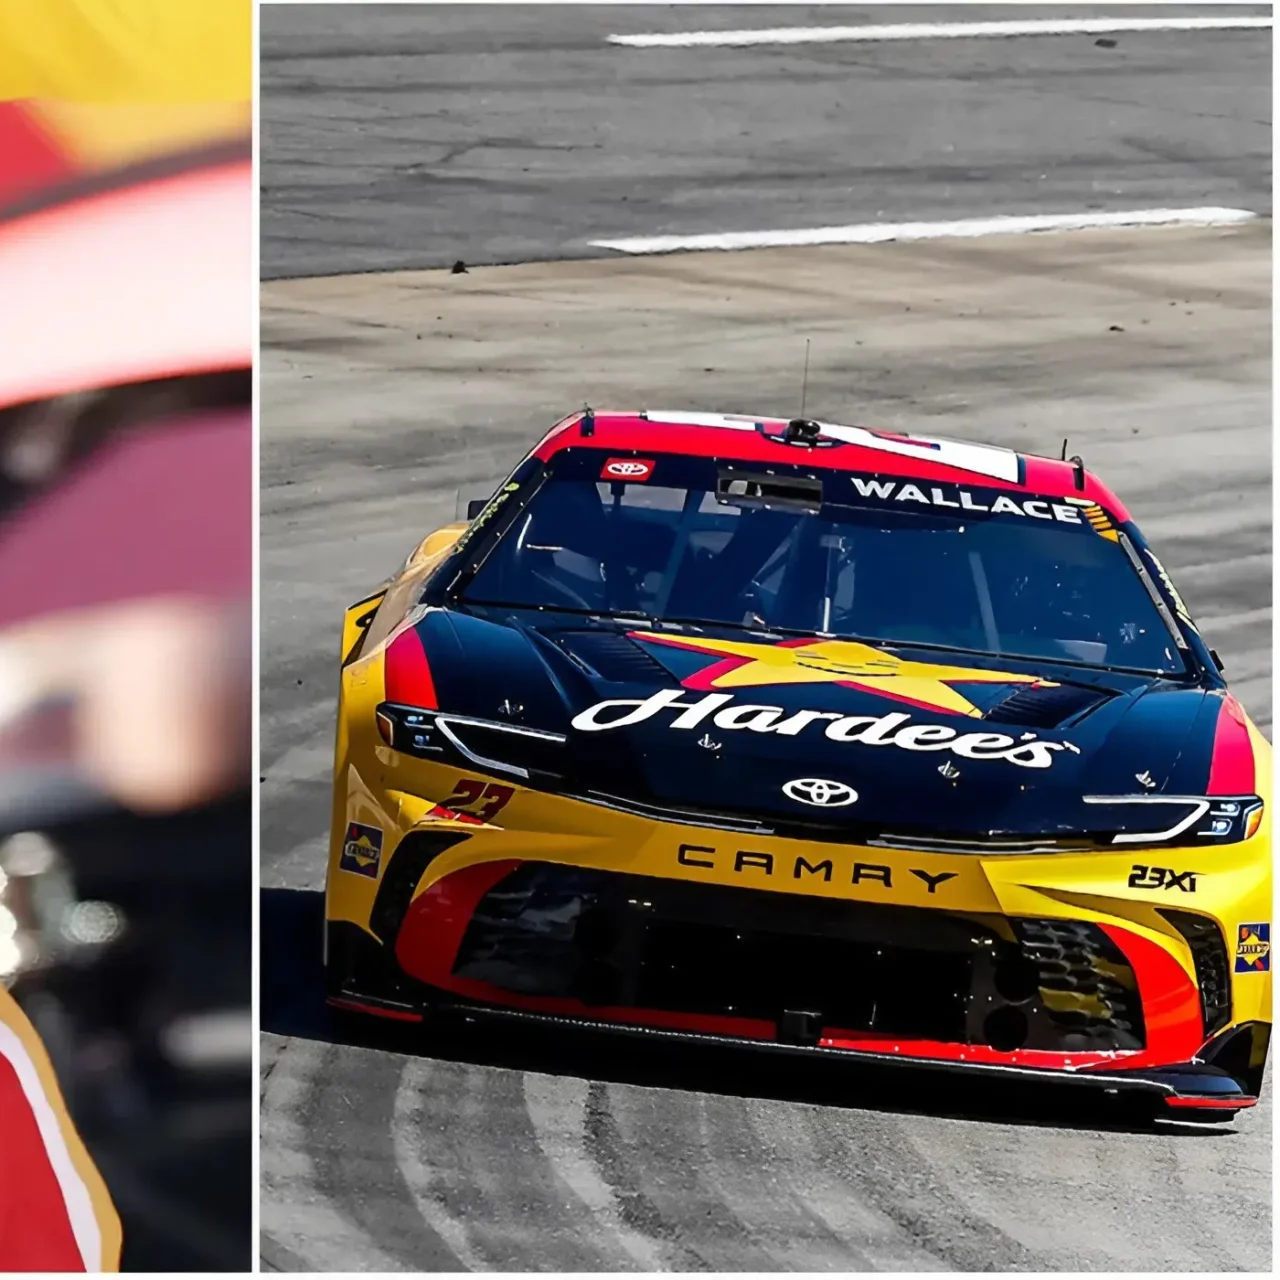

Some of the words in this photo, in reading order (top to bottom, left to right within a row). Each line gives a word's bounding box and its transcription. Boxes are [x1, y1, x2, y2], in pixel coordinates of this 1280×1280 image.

[851, 477, 1083, 525] WALLACE
[571, 688, 1072, 769] Hardee's
[425, 778, 516, 827] 23
[677, 843, 960, 894] CAMRY
